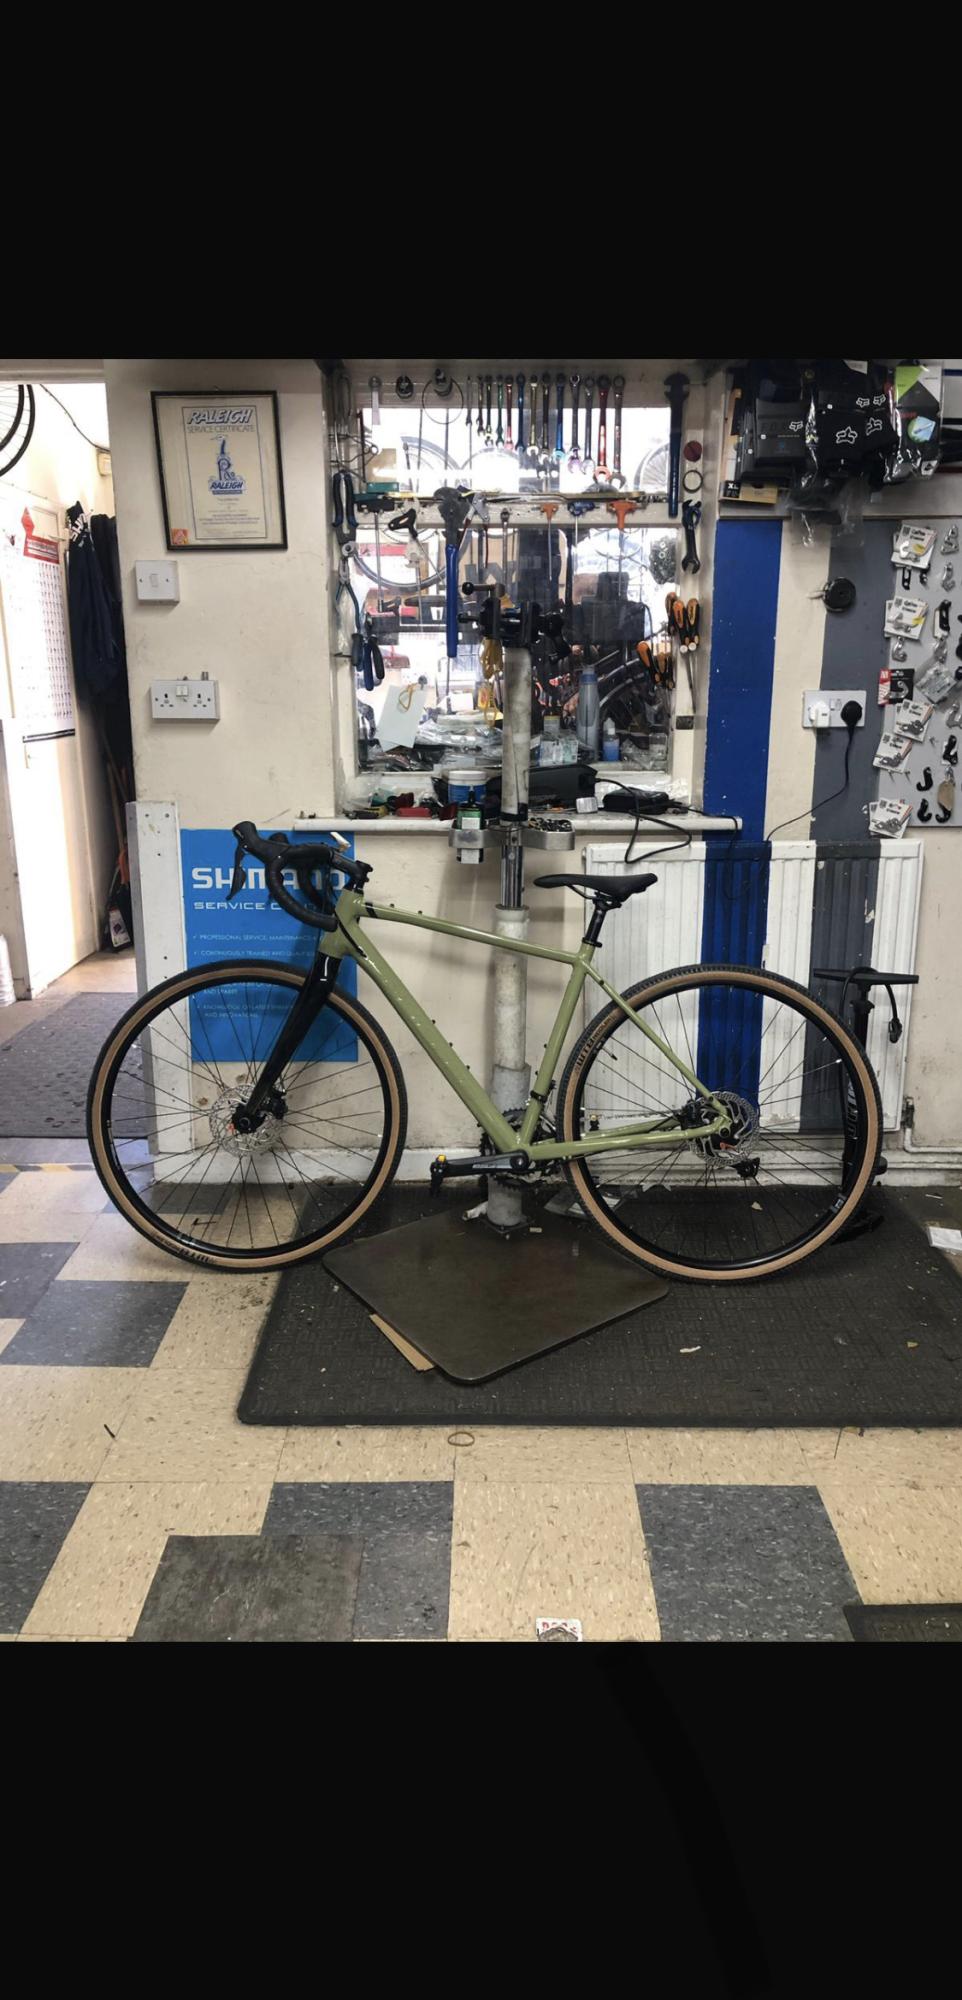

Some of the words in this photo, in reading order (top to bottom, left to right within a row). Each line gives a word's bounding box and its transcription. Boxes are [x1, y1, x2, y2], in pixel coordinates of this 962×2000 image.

[187, 409, 254, 424] RALEIGH
[210, 481, 243, 490] RALEIGH
[191, 867, 346, 890] SHMAO
[194, 902, 265, 910] SERVICE
